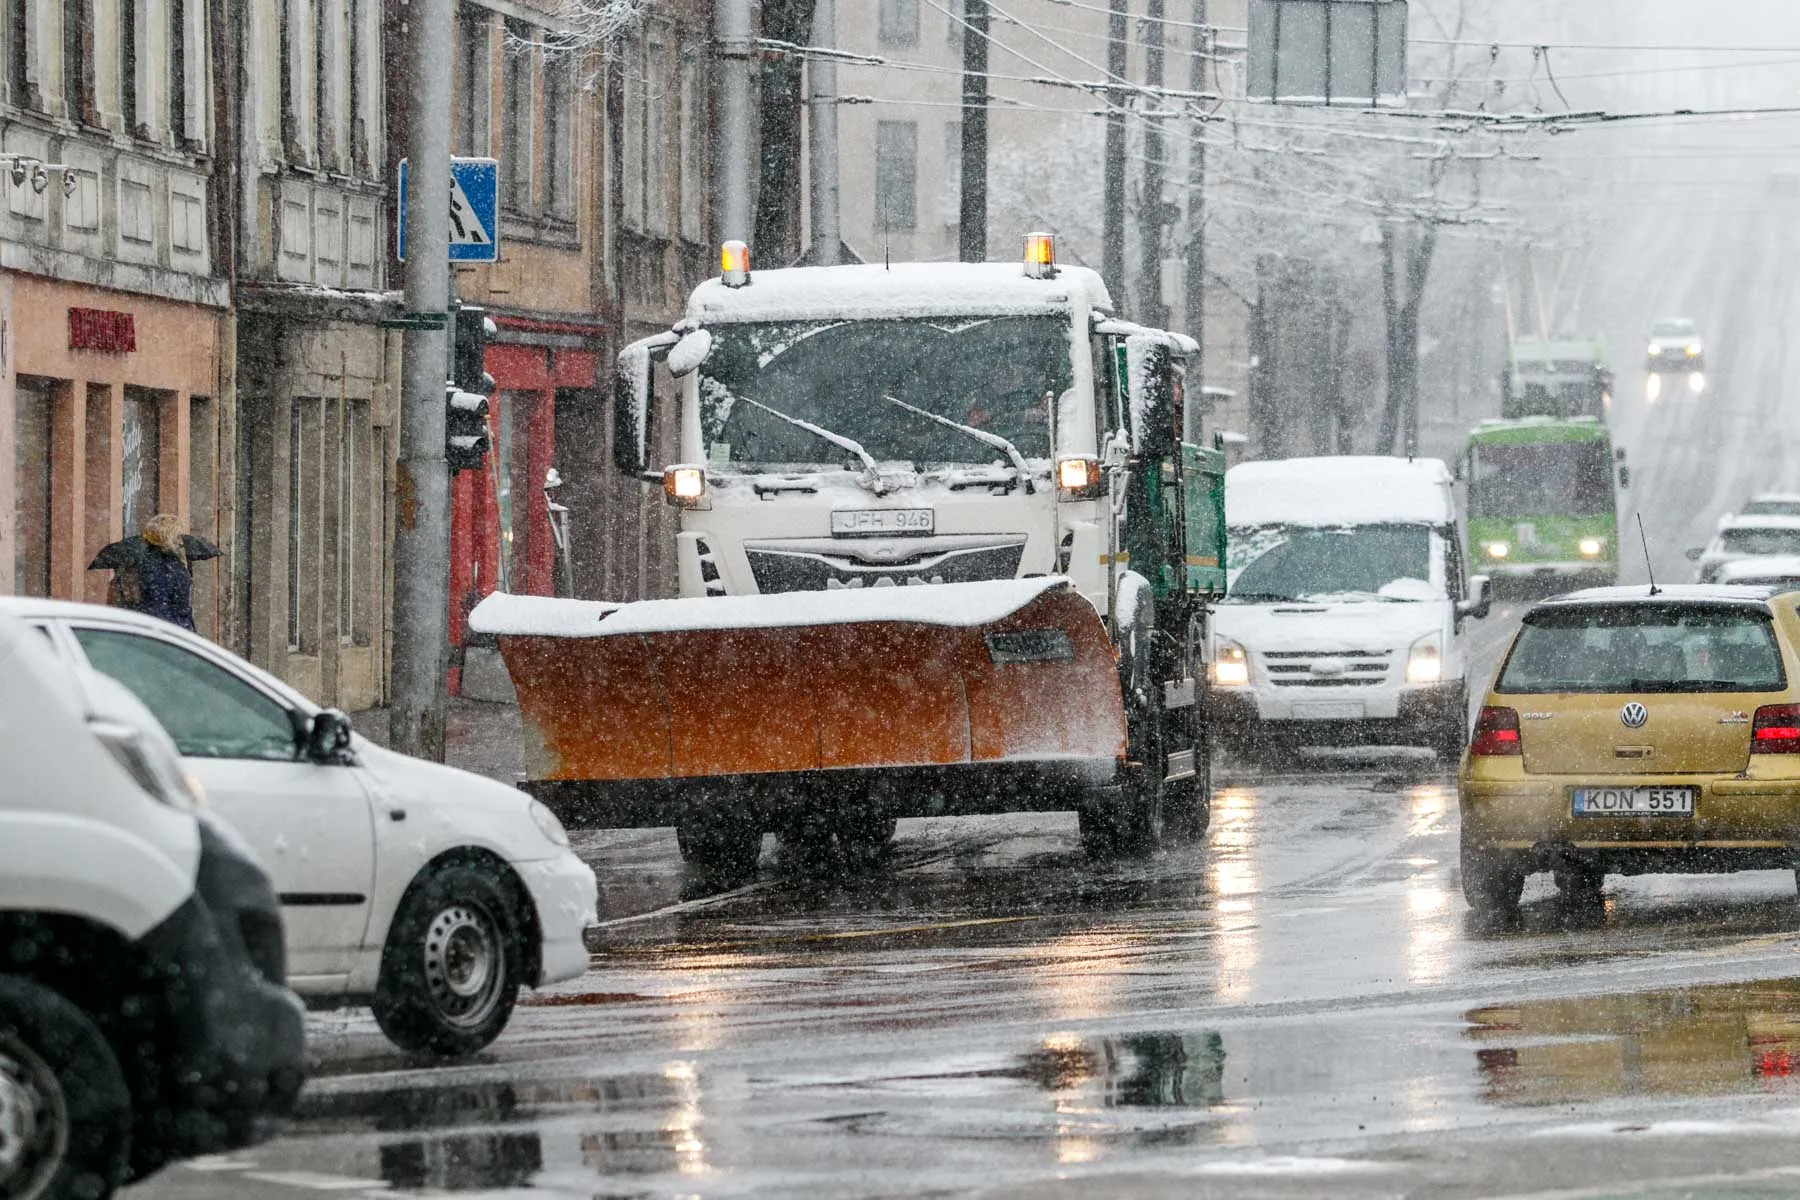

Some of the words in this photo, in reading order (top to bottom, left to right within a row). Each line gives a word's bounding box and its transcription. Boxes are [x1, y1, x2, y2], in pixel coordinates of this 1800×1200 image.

[844, 513, 884, 529] JFH
[896, 512, 930, 528] 946
[1522, 712, 1553, 720] GOLF
[1586, 791, 1634, 810] KDN
[1648, 791, 1686, 810] 551
